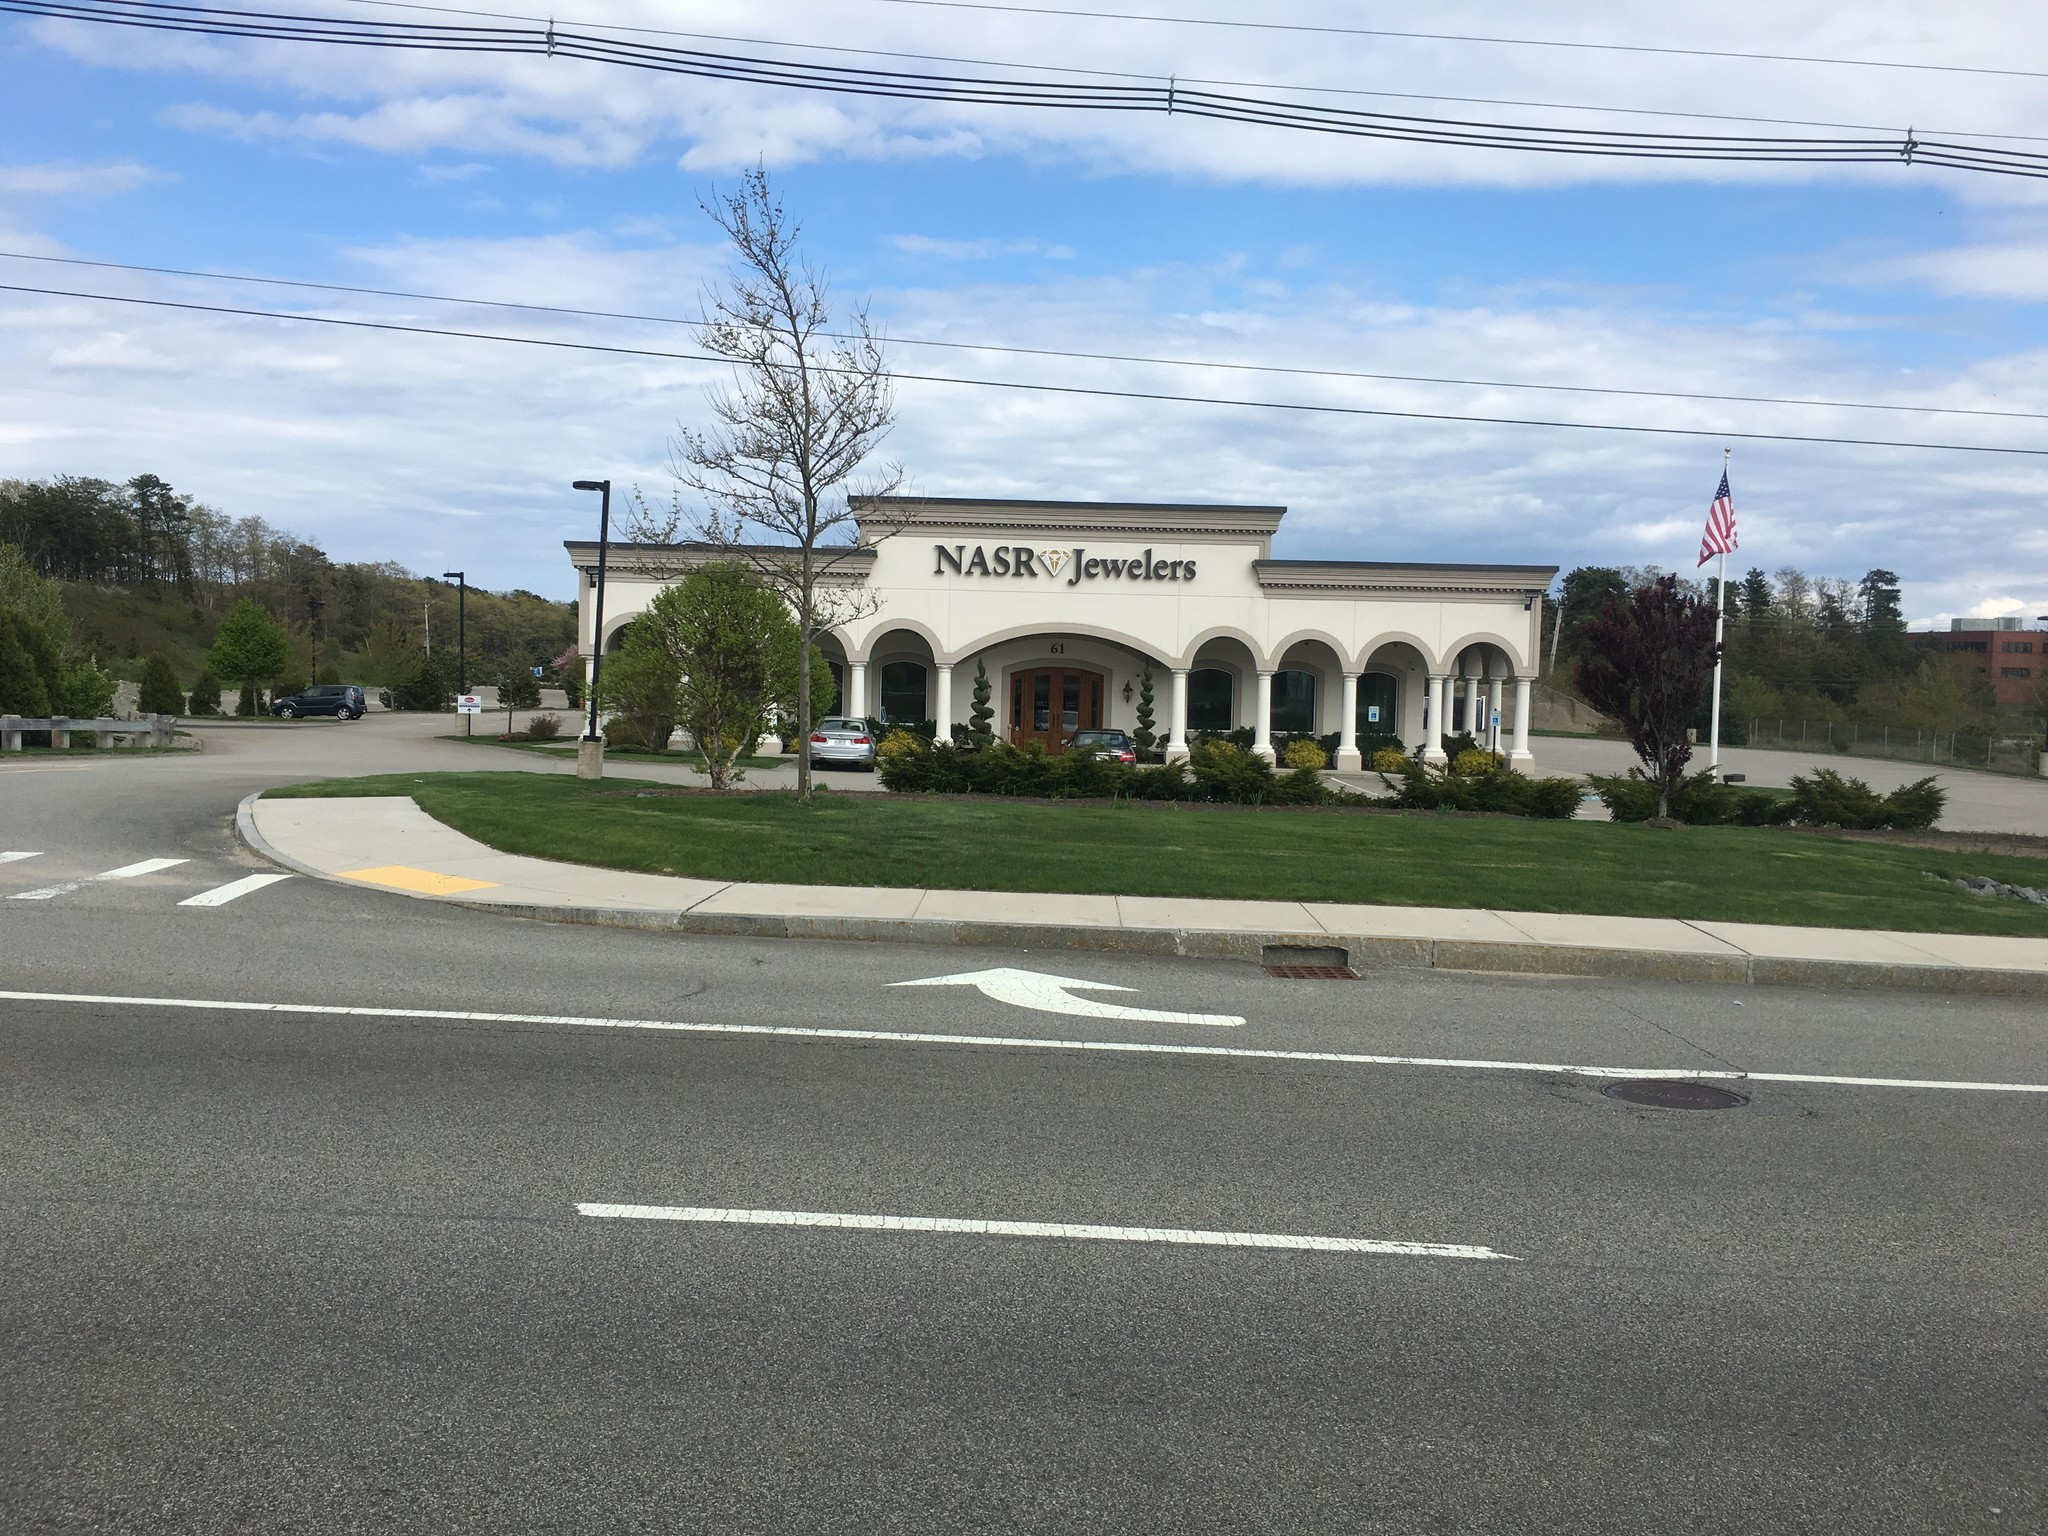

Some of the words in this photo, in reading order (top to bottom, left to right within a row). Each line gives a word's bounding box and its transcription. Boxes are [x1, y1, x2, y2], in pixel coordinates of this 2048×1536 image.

[934, 544, 1039, 578] NASR
[1068, 548, 1197, 586] Jewelers
[1050, 643, 1065, 655] 61
